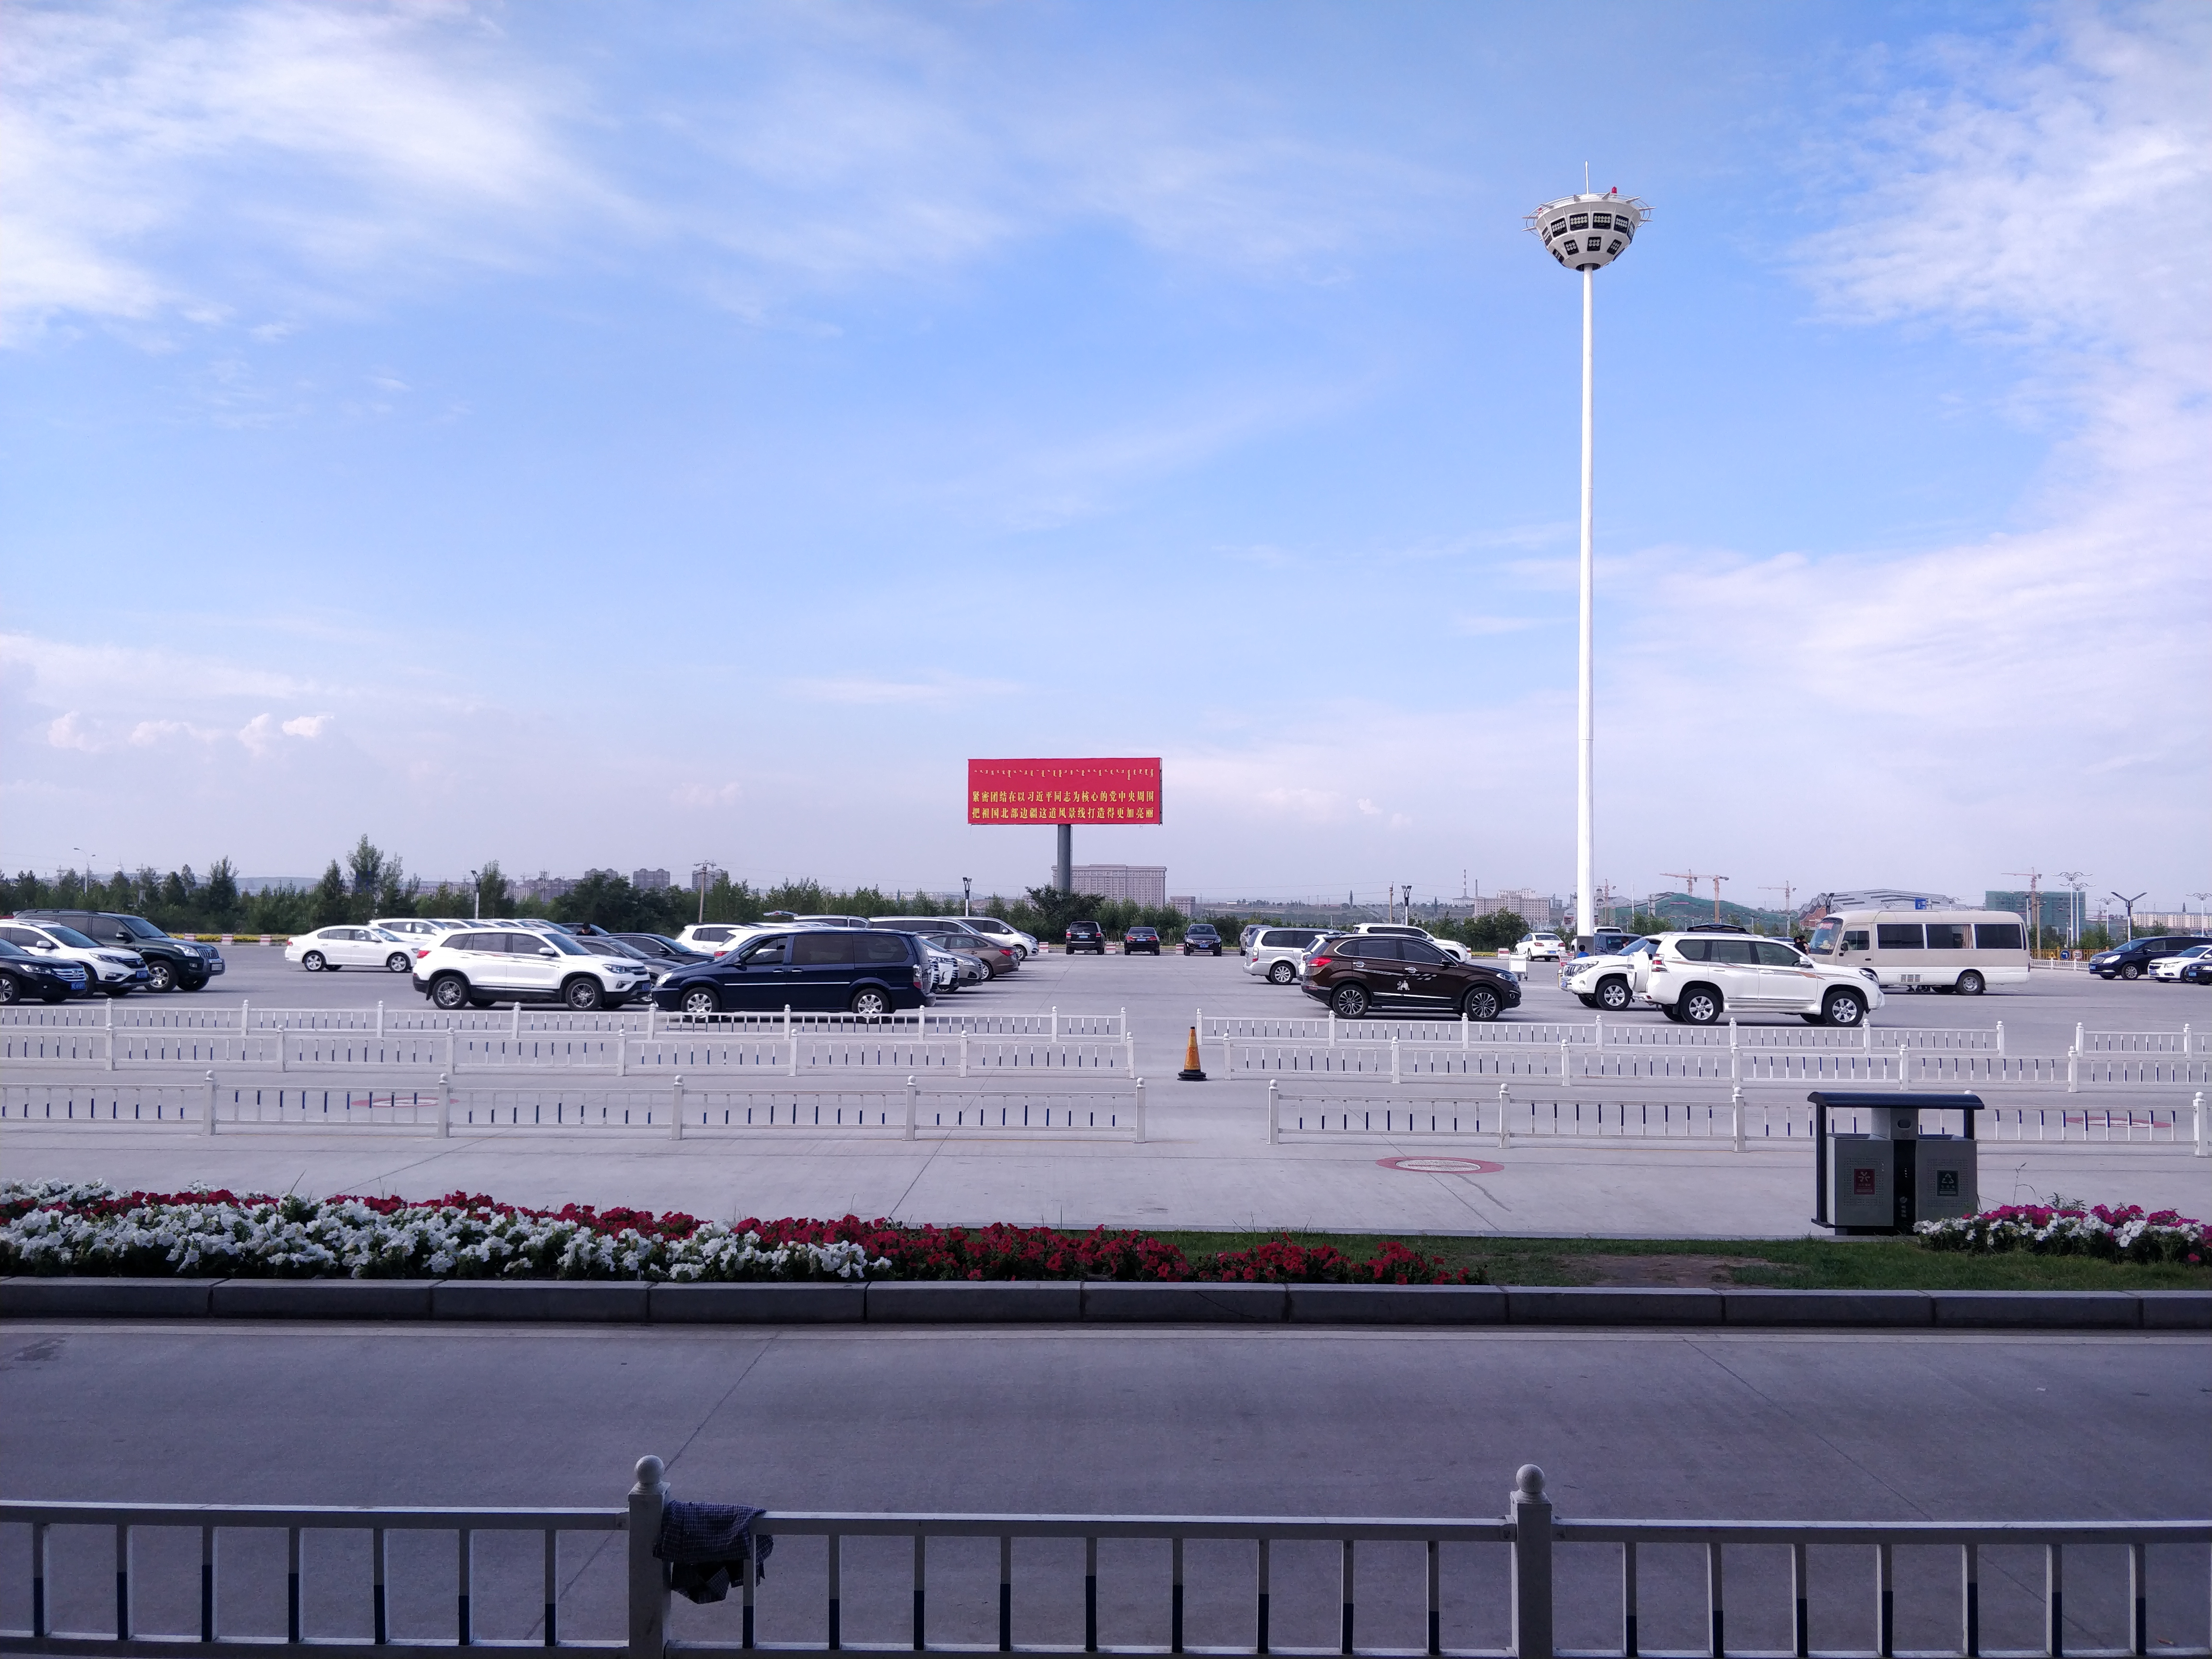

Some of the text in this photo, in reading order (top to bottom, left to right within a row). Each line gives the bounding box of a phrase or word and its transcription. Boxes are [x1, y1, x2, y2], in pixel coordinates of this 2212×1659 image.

[973, 791, 1154, 803] 紧密团结在以习近平同志为核心的党中央周围
[972, 807, 1154, 819] 把祖国北部边疆这道风景线打造得更加亮丽
